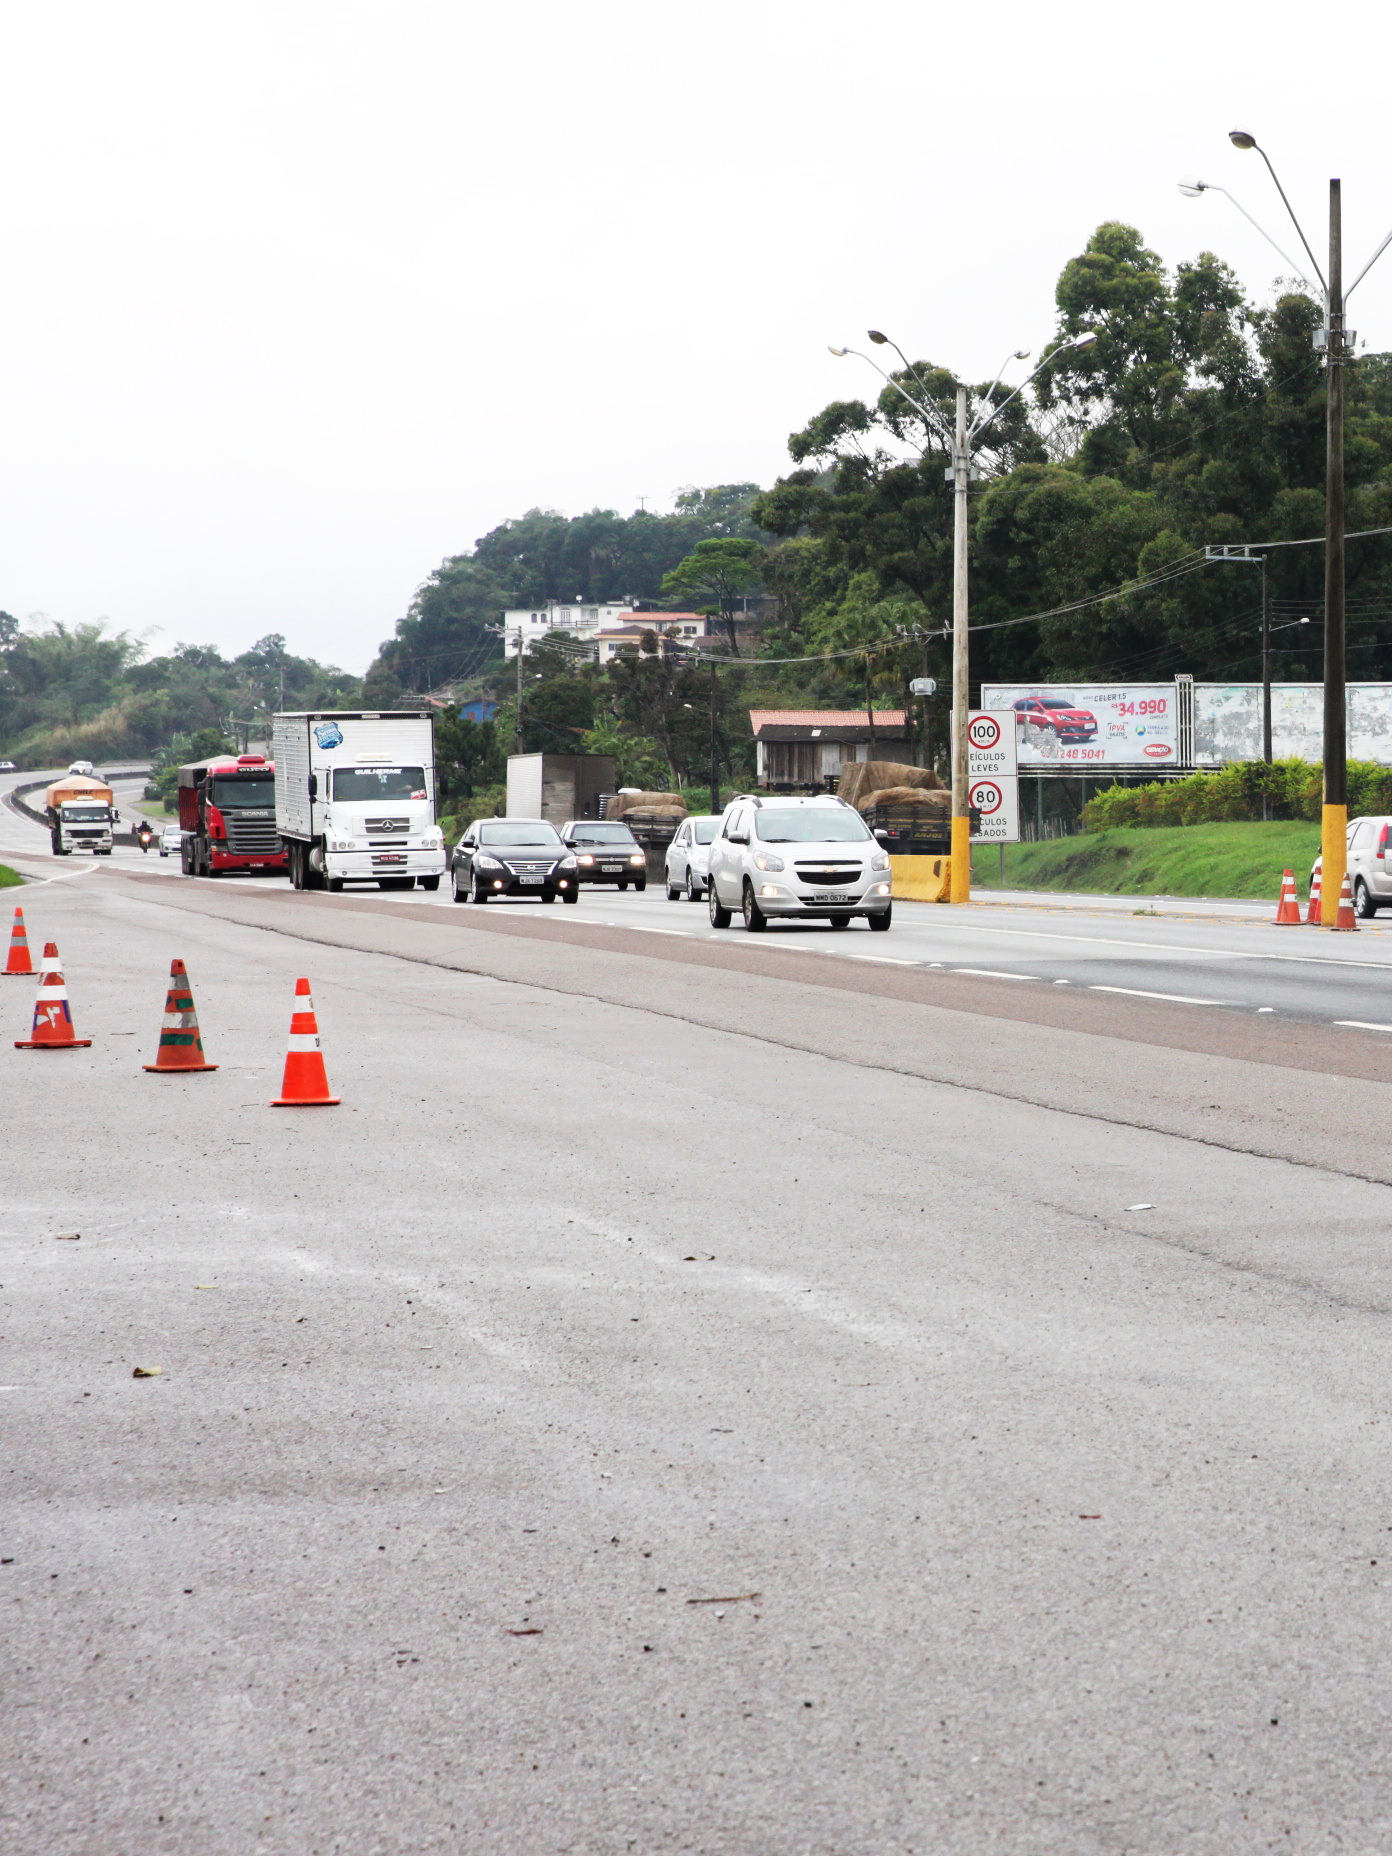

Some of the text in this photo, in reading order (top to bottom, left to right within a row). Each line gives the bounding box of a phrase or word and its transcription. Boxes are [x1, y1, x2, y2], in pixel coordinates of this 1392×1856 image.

[1094, 694, 1117, 702] CELER
[973, 725, 995, 738] 100
[969, 752, 1006, 761] EÍCULOS
[1081, 749, 1105, 759] 5041
[971, 764, 999, 772] LEVES
[976, 790, 995, 803] 80
